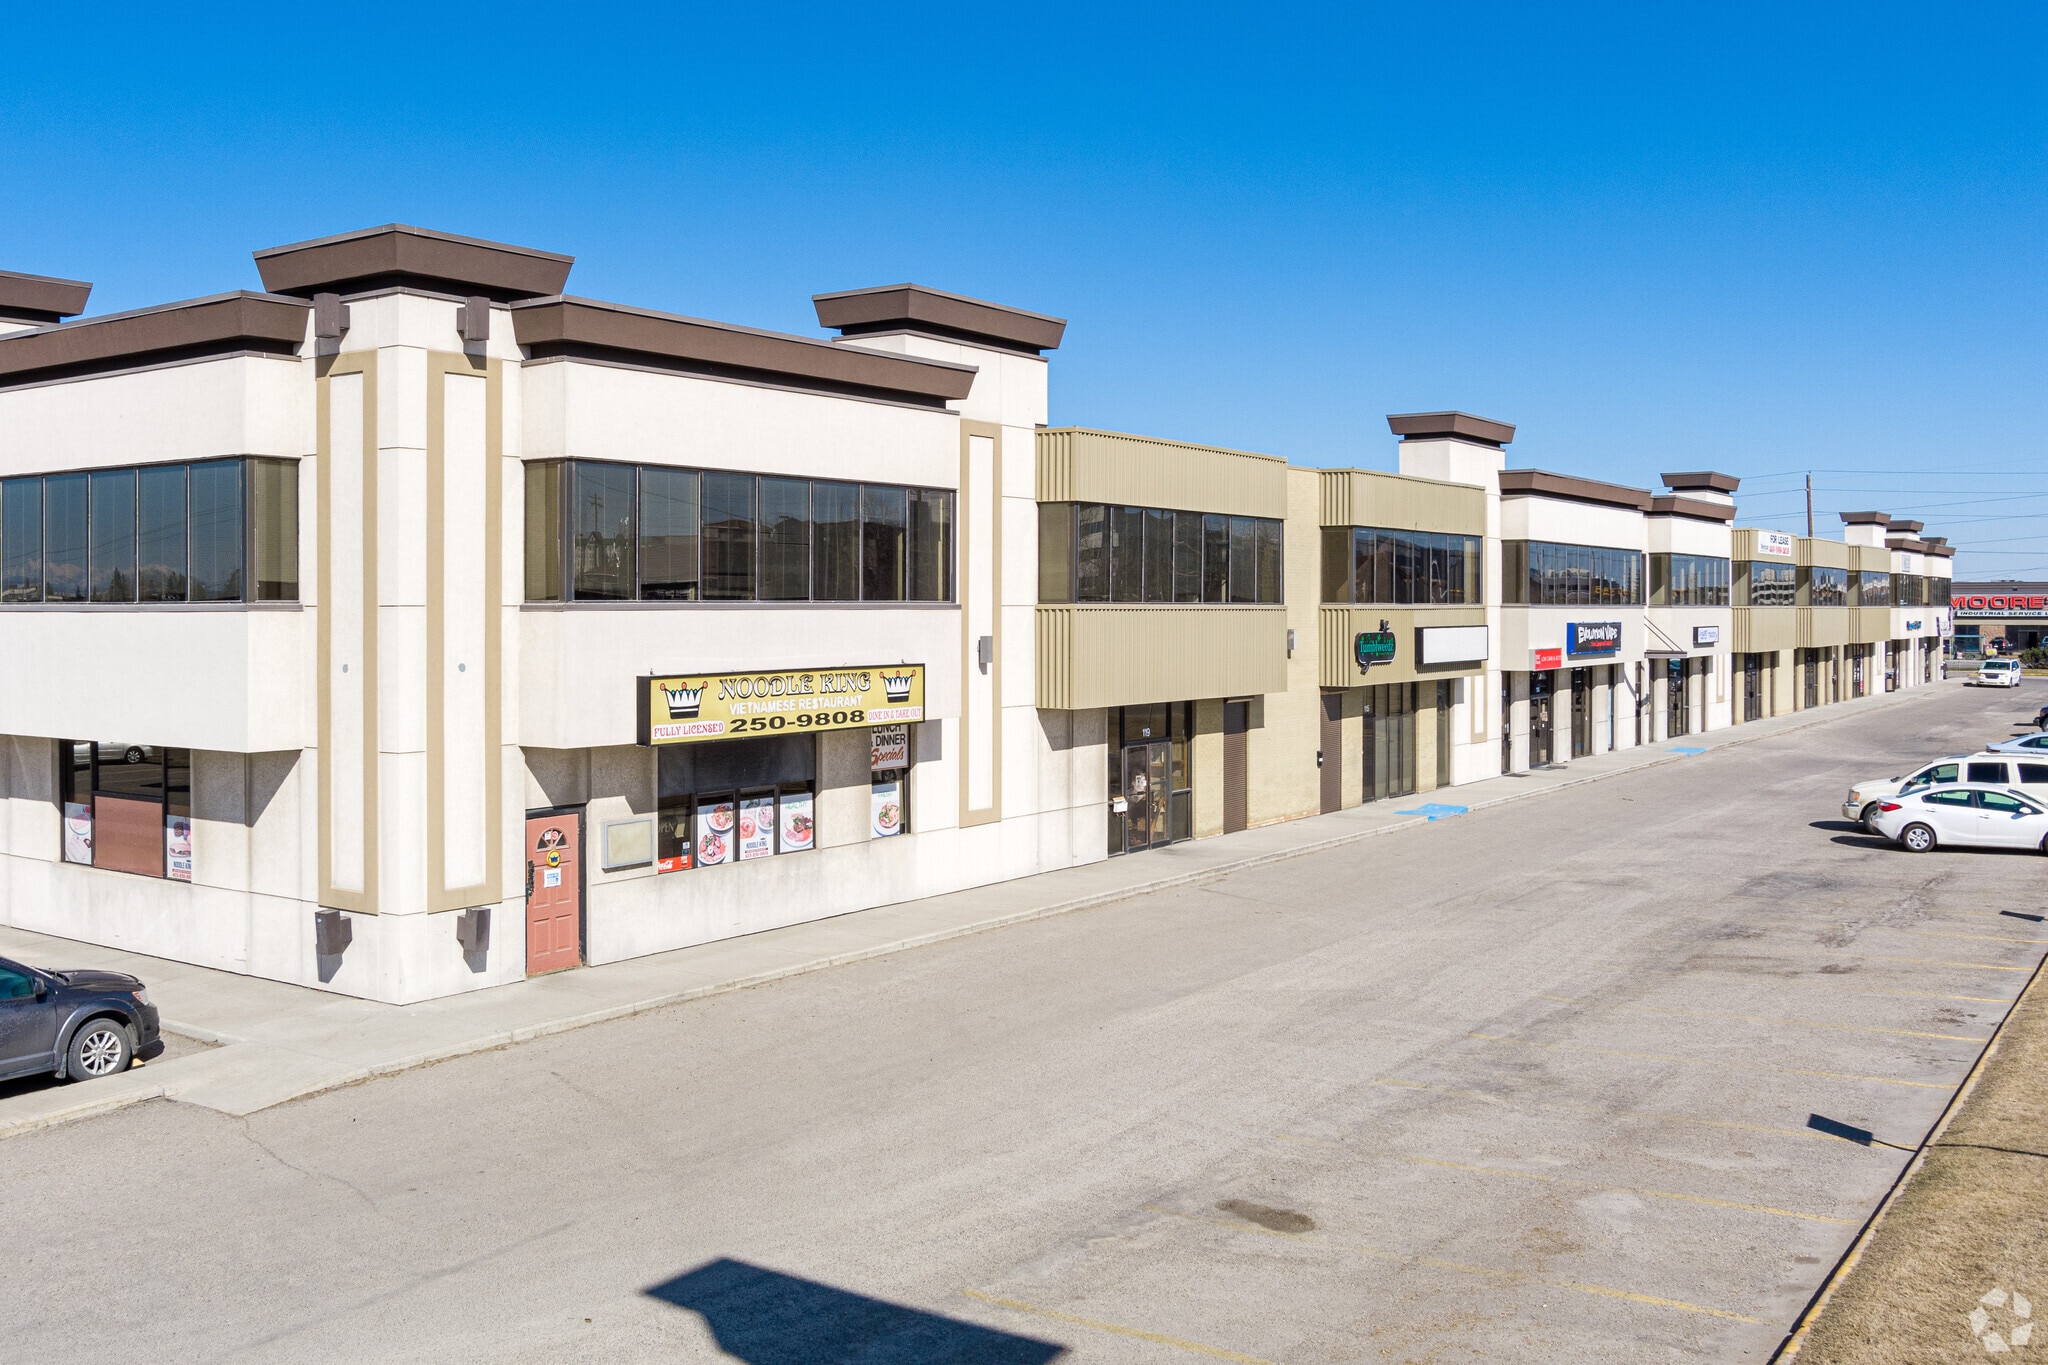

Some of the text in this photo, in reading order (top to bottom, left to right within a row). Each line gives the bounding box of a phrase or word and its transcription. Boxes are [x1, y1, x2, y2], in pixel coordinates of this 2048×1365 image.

[1778, 536, 1789, 545] LEASE
[1951, 595, 2048, 609] MOORE
[718, 672, 871, 700] NOODLE KING
[729, 695, 863, 715] VIETNAMESE RESTAURANT
[729, 710, 865, 733] 250-9808
[868, 710, 882, 721] DINE
[883, 710, 890, 719] IN
[895, 709, 910, 719] TAKE
[910, 708, 921, 718] OUT
[654, 722, 724, 737] FULLY LICENSED
[872, 724, 901, 734] LUNCH
[875, 733, 906, 747] DINNER
[871, 746, 905, 766] Specials
[658, 821, 674, 833] PEN
